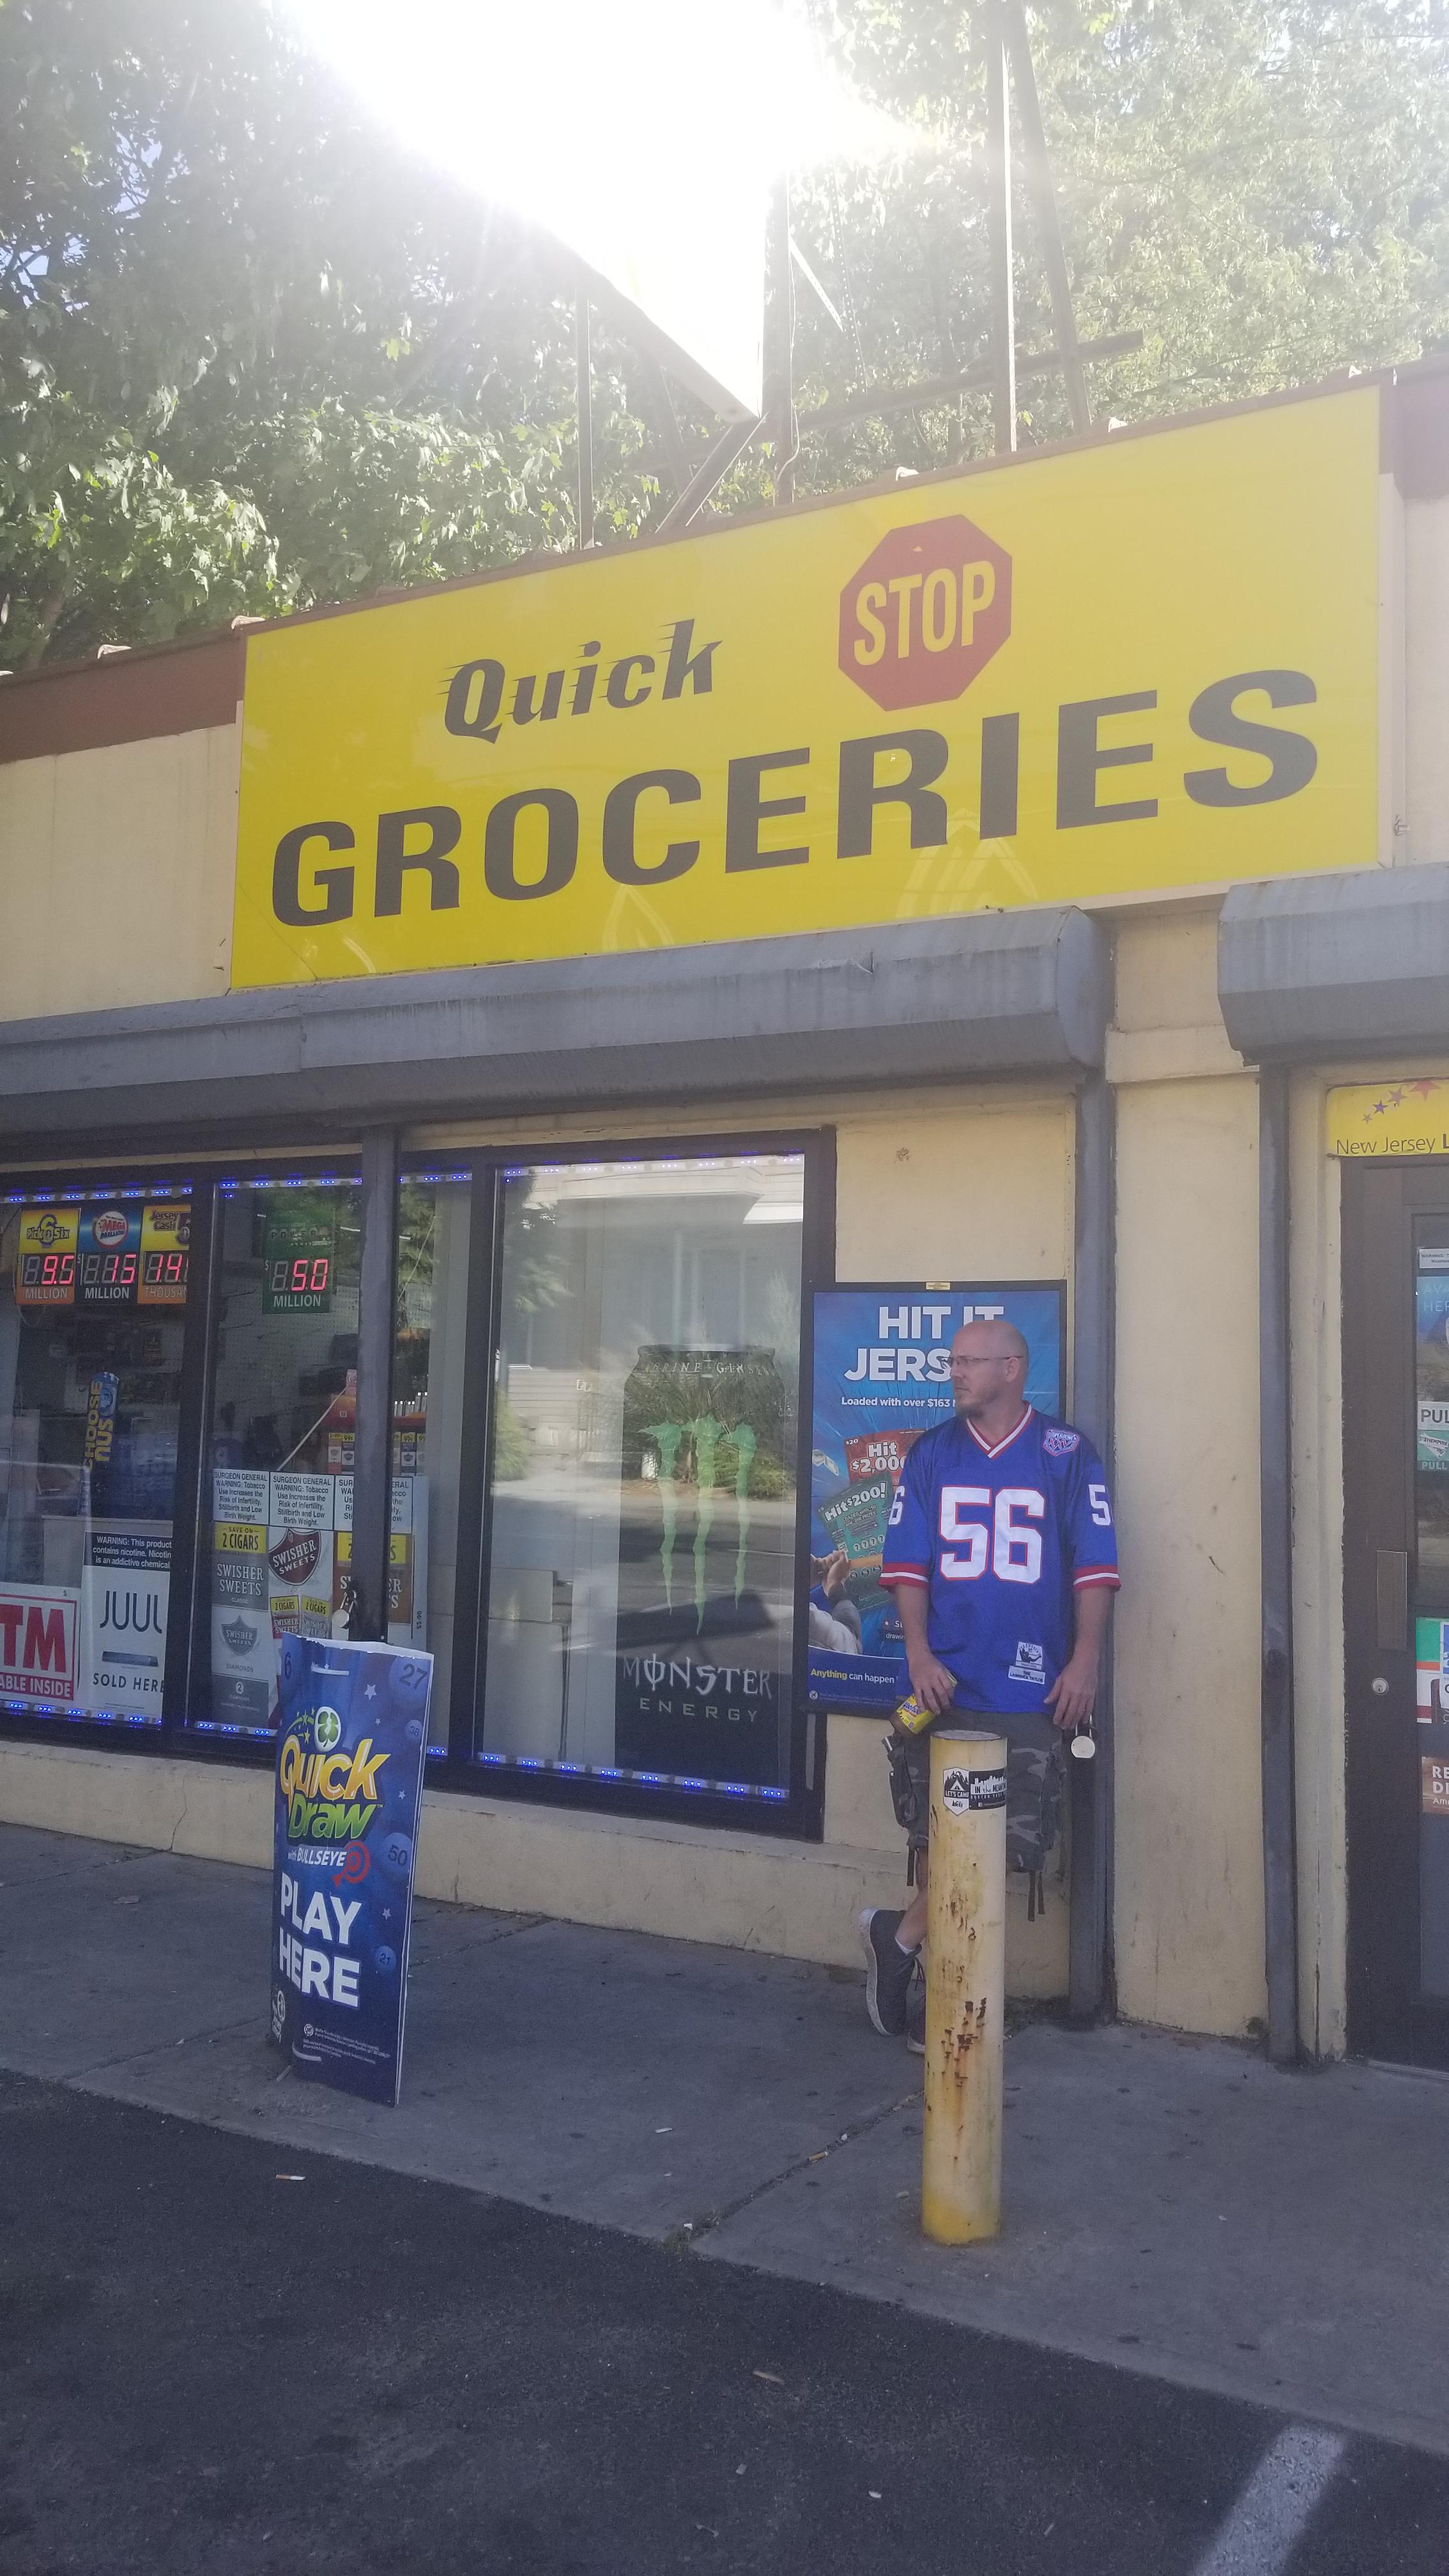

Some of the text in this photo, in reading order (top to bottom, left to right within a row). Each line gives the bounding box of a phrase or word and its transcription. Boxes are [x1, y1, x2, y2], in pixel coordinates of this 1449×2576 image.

[854, 560, 995, 666] STOP
[437, 618, 723, 744] Quick
[272, 670, 1317, 926] GROCERIES
[1337, 1139, 1377, 1154] New
[1382, 1137, 1436, 1154] Jersey
[149, 1210, 179, 1222] Jersey
[112, 1254, 137, 1284] 15
[157, 1254, 189, 1282] 14
[291, 1259, 328, 1291] 50
[25, 1287, 68, 1300] MILLION
[84, 1287, 130, 1300] MILLION
[273, 1294, 321, 1308] MILLION
[878, 1306, 951, 1339] HIT
[843, 1347, 952, 1383] JERS
[841, 1397, 878, 1406] Loaded
[880, 1397, 901, 1406] with
[927, 1398, 951, 1407] $163
[1421, 1409, 1449, 1423] PUL
[868, 1441, 898, 1458] Hit
[1422, 1461, 1447, 1470] PULL
[214, 1471, 268, 1482] SURGEON GENERAL
[216, 1480, 243, 1488] WARNING:
[273, 1475, 332, 1486] SURGEON GENERAL
[275, 1483, 304, 1492] WARNING:
[289, 1493, 316, 1501] Increases
[824, 1481, 887, 1522] Hit $200!
[277, 1508, 300, 1517] Stillbirth
[298, 1517, 319, 1527] Weight.
[96, 1535, 172, 1549] WARNING: This product
[222, 1532, 259, 1551] 2 CIGARS
[940, 1485, 1046, 1584] 56
[93, 1546, 119, 1555] contains
[148, 1549, 171, 1559] Nicotin
[111, 1557, 140, 1567] addictive
[273, 1539, 317, 1568] SWISHER
[217, 1563, 264, 1581] SWISHER
[279, 1553, 316, 1575] SWEETS
[219, 1579, 261, 1596] SWEETS
[99, 1590, 163, 1634] JUUL
[273, 1618, 299, 1627] SWISHER
[0, 1602, 67, 1674] TM
[93, 1672, 164, 1694] SOLD HERE
[398, 1662, 428, 1692] 27
[623, 1653, 772, 1700] MONSTER
[810, 1667, 895, 1684] Anything can happen
[30, 1678, 71, 1698] INSIDE
[640, 1697, 757, 1722] ENERGY
[280, 1734, 392, 1818] Quick
[288, 1793, 377, 1839] Draw
[288, 1847, 348, 1867] with BULLSEYE
[388, 1843, 408, 1866] 50
[280, 1871, 362, 1945] PLAY
[279, 1926, 360, 2008] HERE
